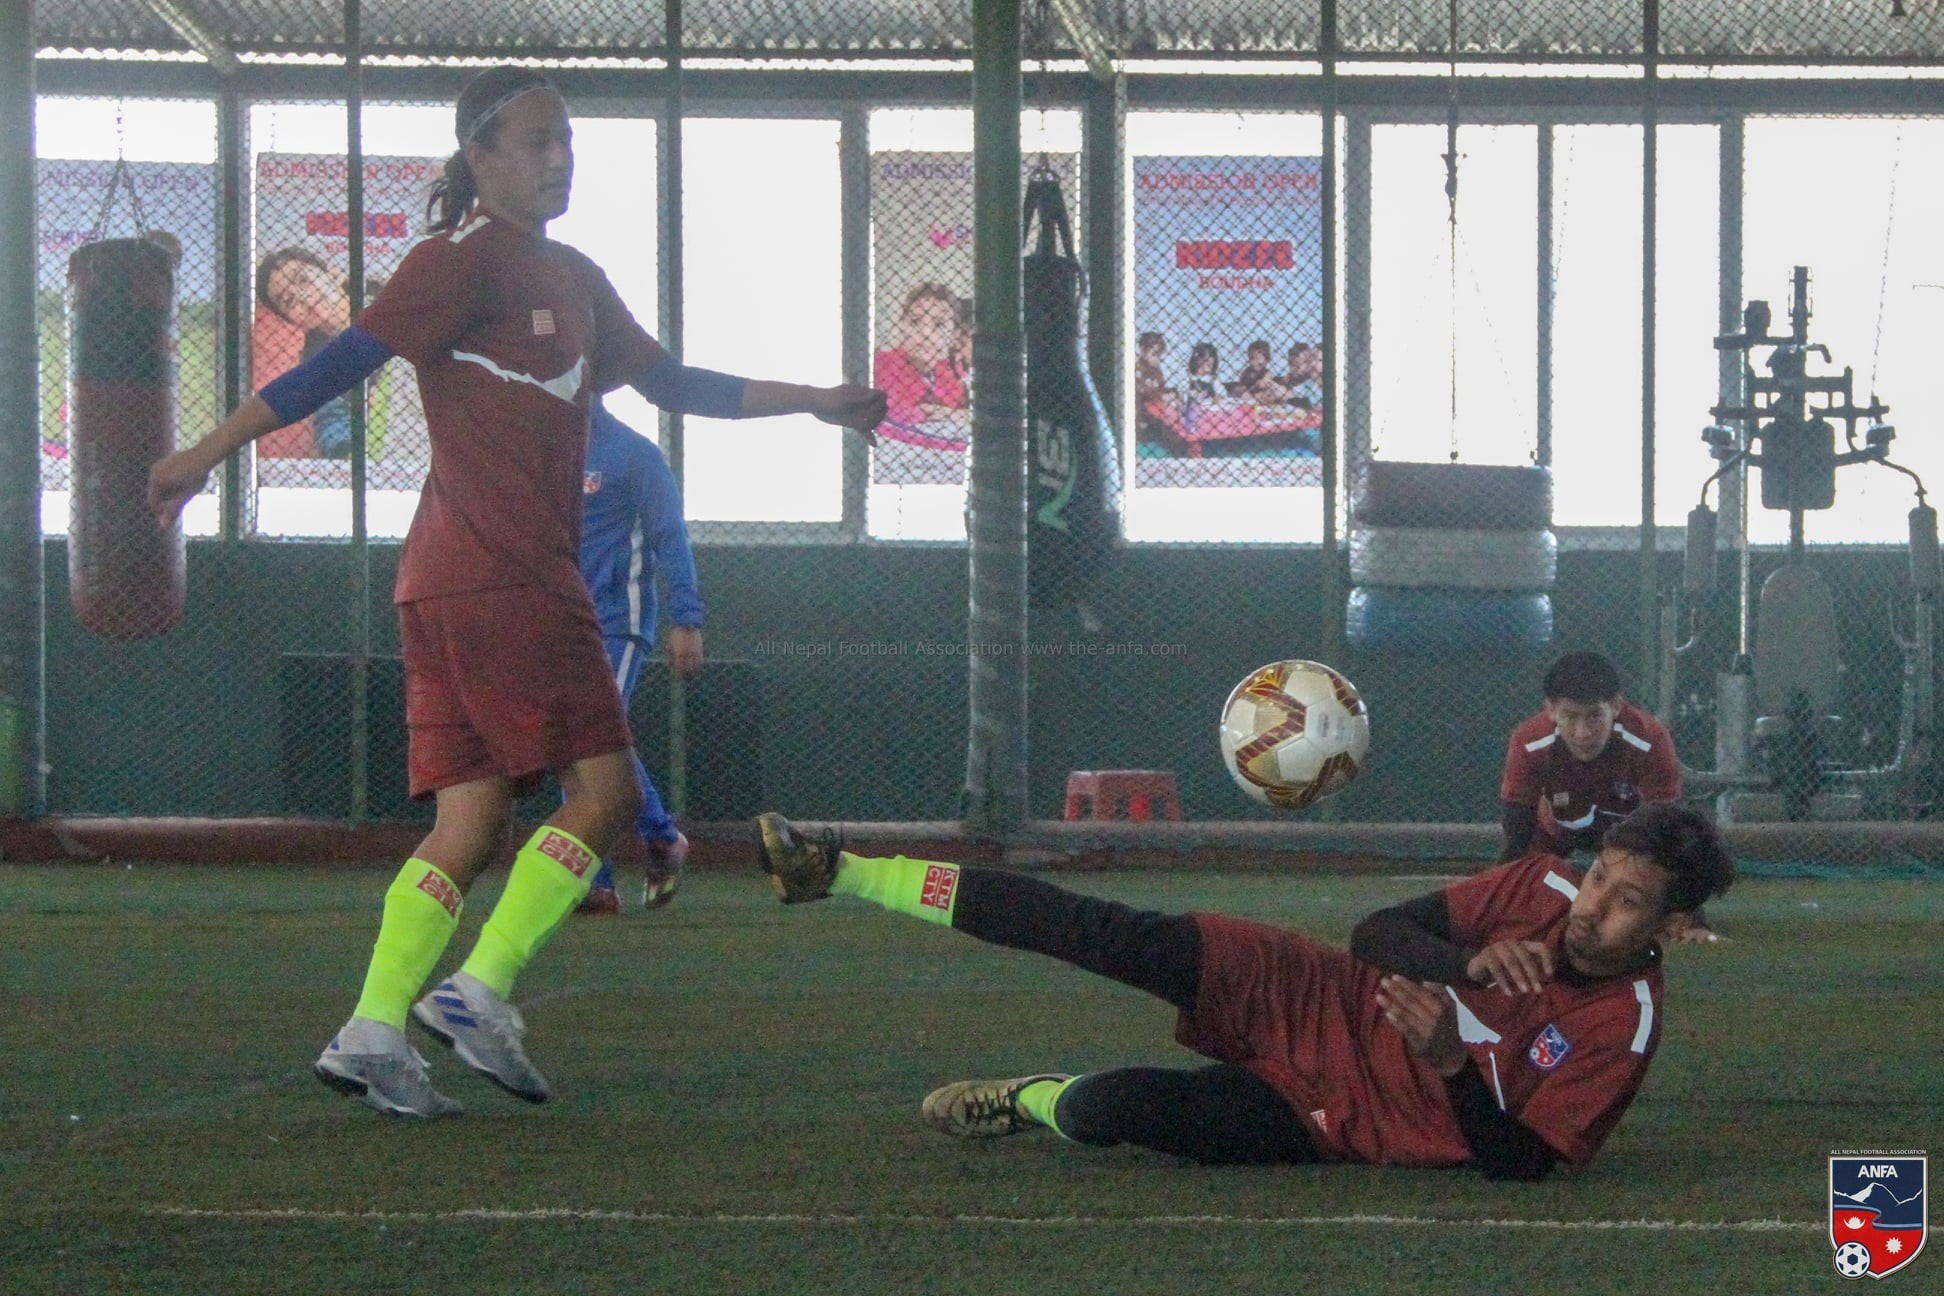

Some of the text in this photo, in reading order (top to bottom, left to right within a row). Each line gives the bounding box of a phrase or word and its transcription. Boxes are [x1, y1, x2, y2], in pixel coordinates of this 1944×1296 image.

[1140, 173, 1319, 191] ADMISSION OPEN
[1175, 239, 1297, 270] KIDZEE
[922, 866, 942, 903] CTY
[936, 869, 957, 909] KTM
